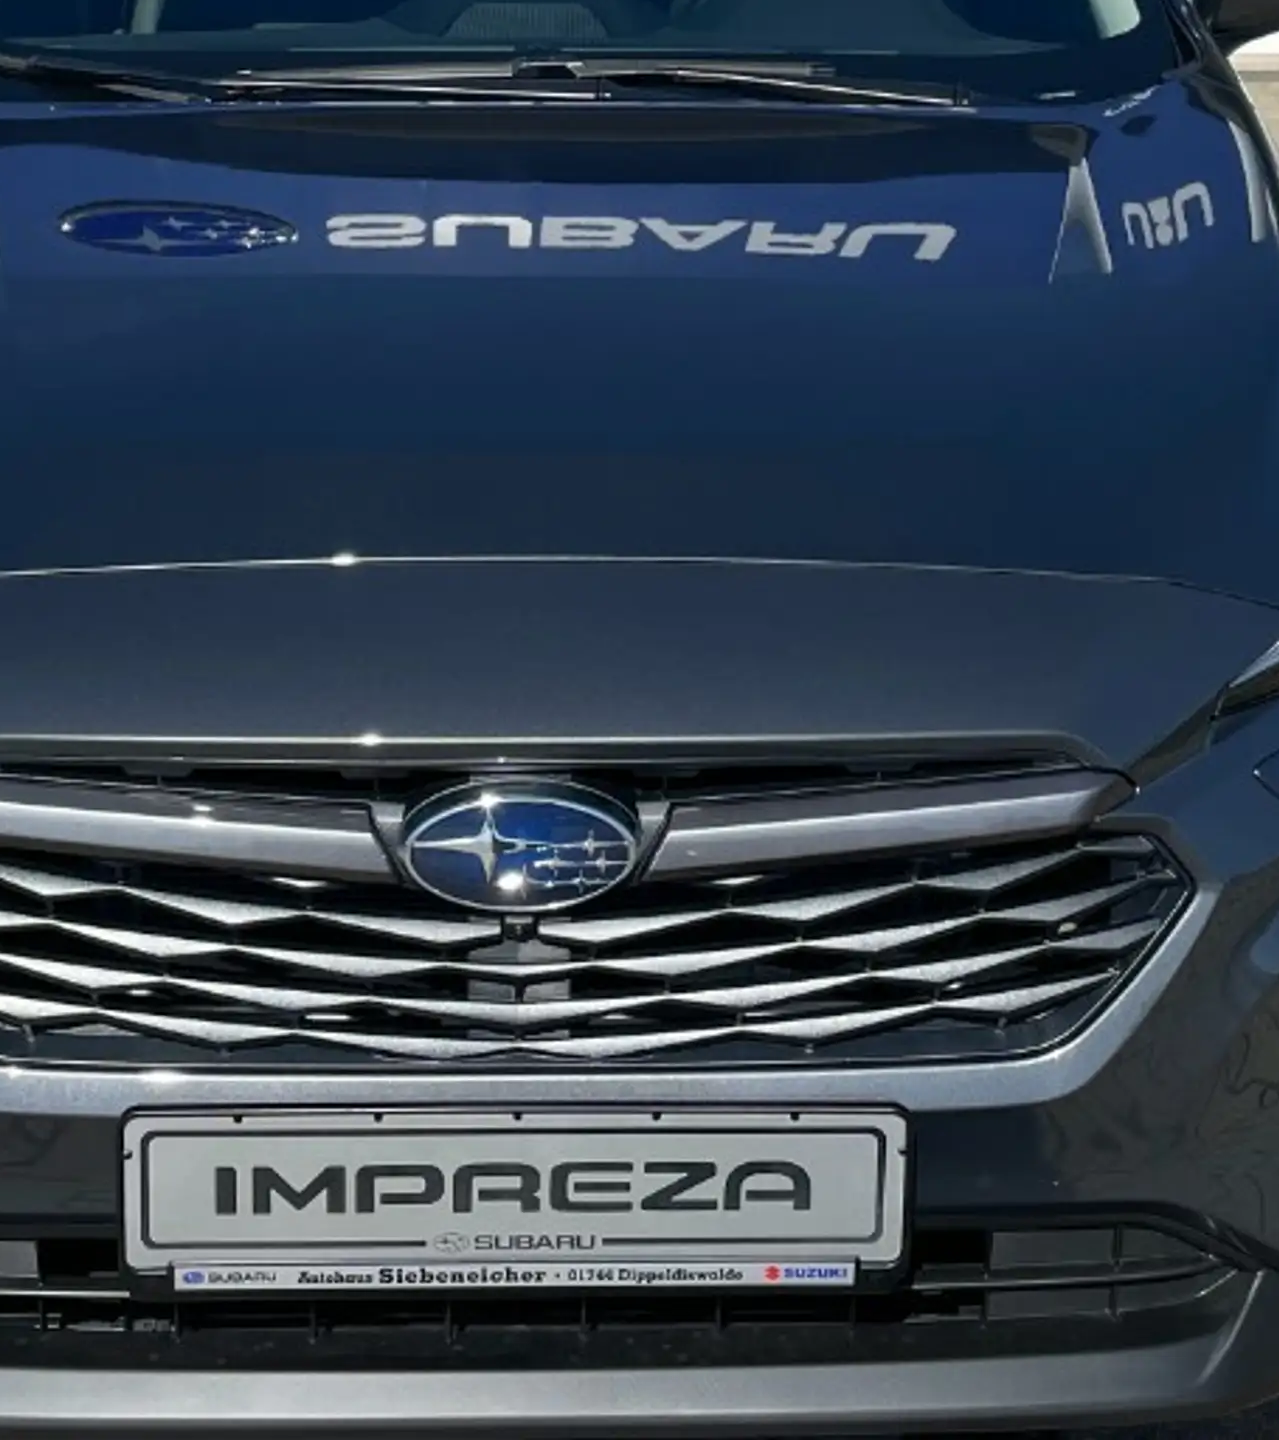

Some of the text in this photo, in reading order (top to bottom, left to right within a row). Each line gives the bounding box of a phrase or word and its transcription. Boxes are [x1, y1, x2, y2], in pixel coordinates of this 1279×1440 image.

[214, 1160, 812, 1215] IMPREZA
[473, 1234, 597, 1251] SUBARU
[207, 1271, 277, 1283] SUBARU
[297, 1270, 373, 1284] Autohaus
[378, 1267, 547, 1284] Siebeneicher
[783, 1267, 848, 1279] SUZUKI
